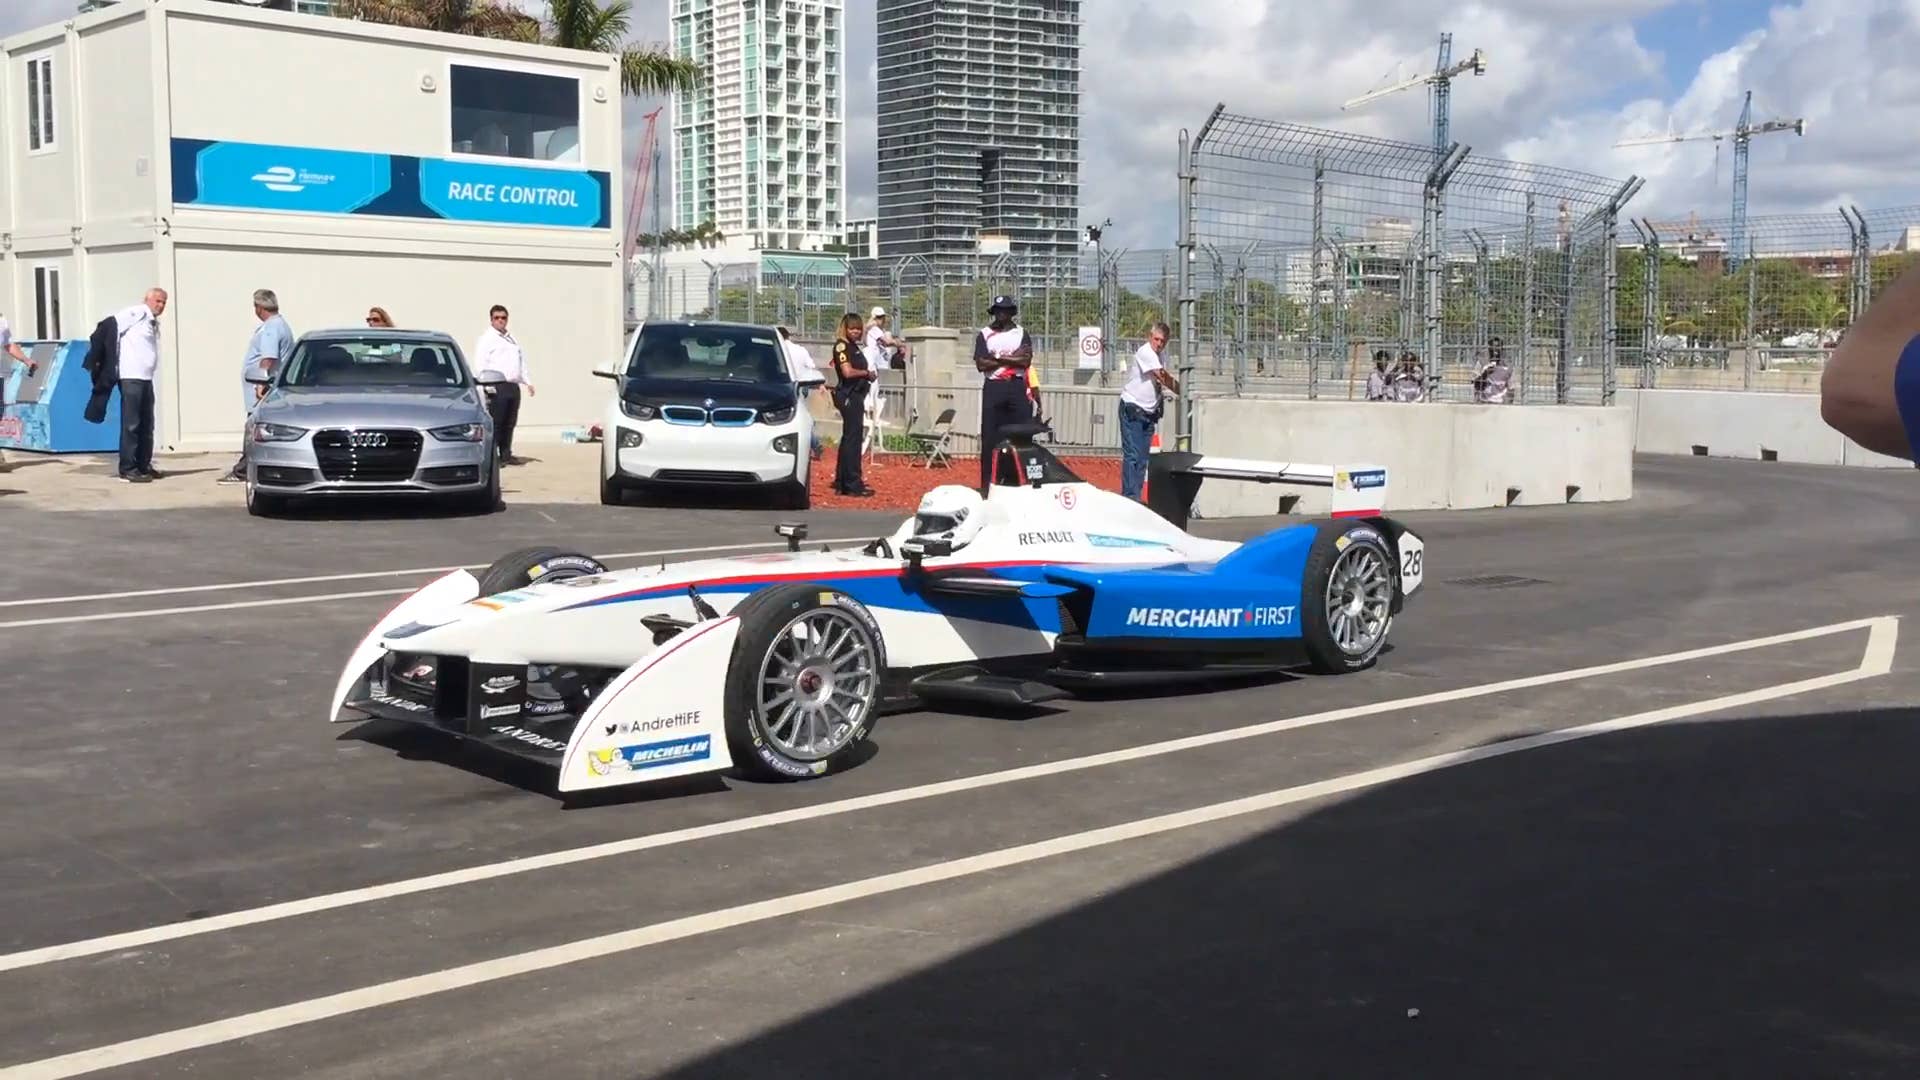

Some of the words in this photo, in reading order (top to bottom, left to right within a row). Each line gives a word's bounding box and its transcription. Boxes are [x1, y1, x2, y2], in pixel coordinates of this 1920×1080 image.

[448, 181, 496, 202] RACE
[500, 185, 579, 208] CONTROL
[1085, 339, 1099, 351] 50
[1018, 530, 1075, 546] RENAULT
[1402, 549, 1423, 577] 28
[1126, 607, 1244, 628] MERCHANT
[1254, 605, 1296, 627] FIRST
[631, 740, 710, 763] MICHELIN
